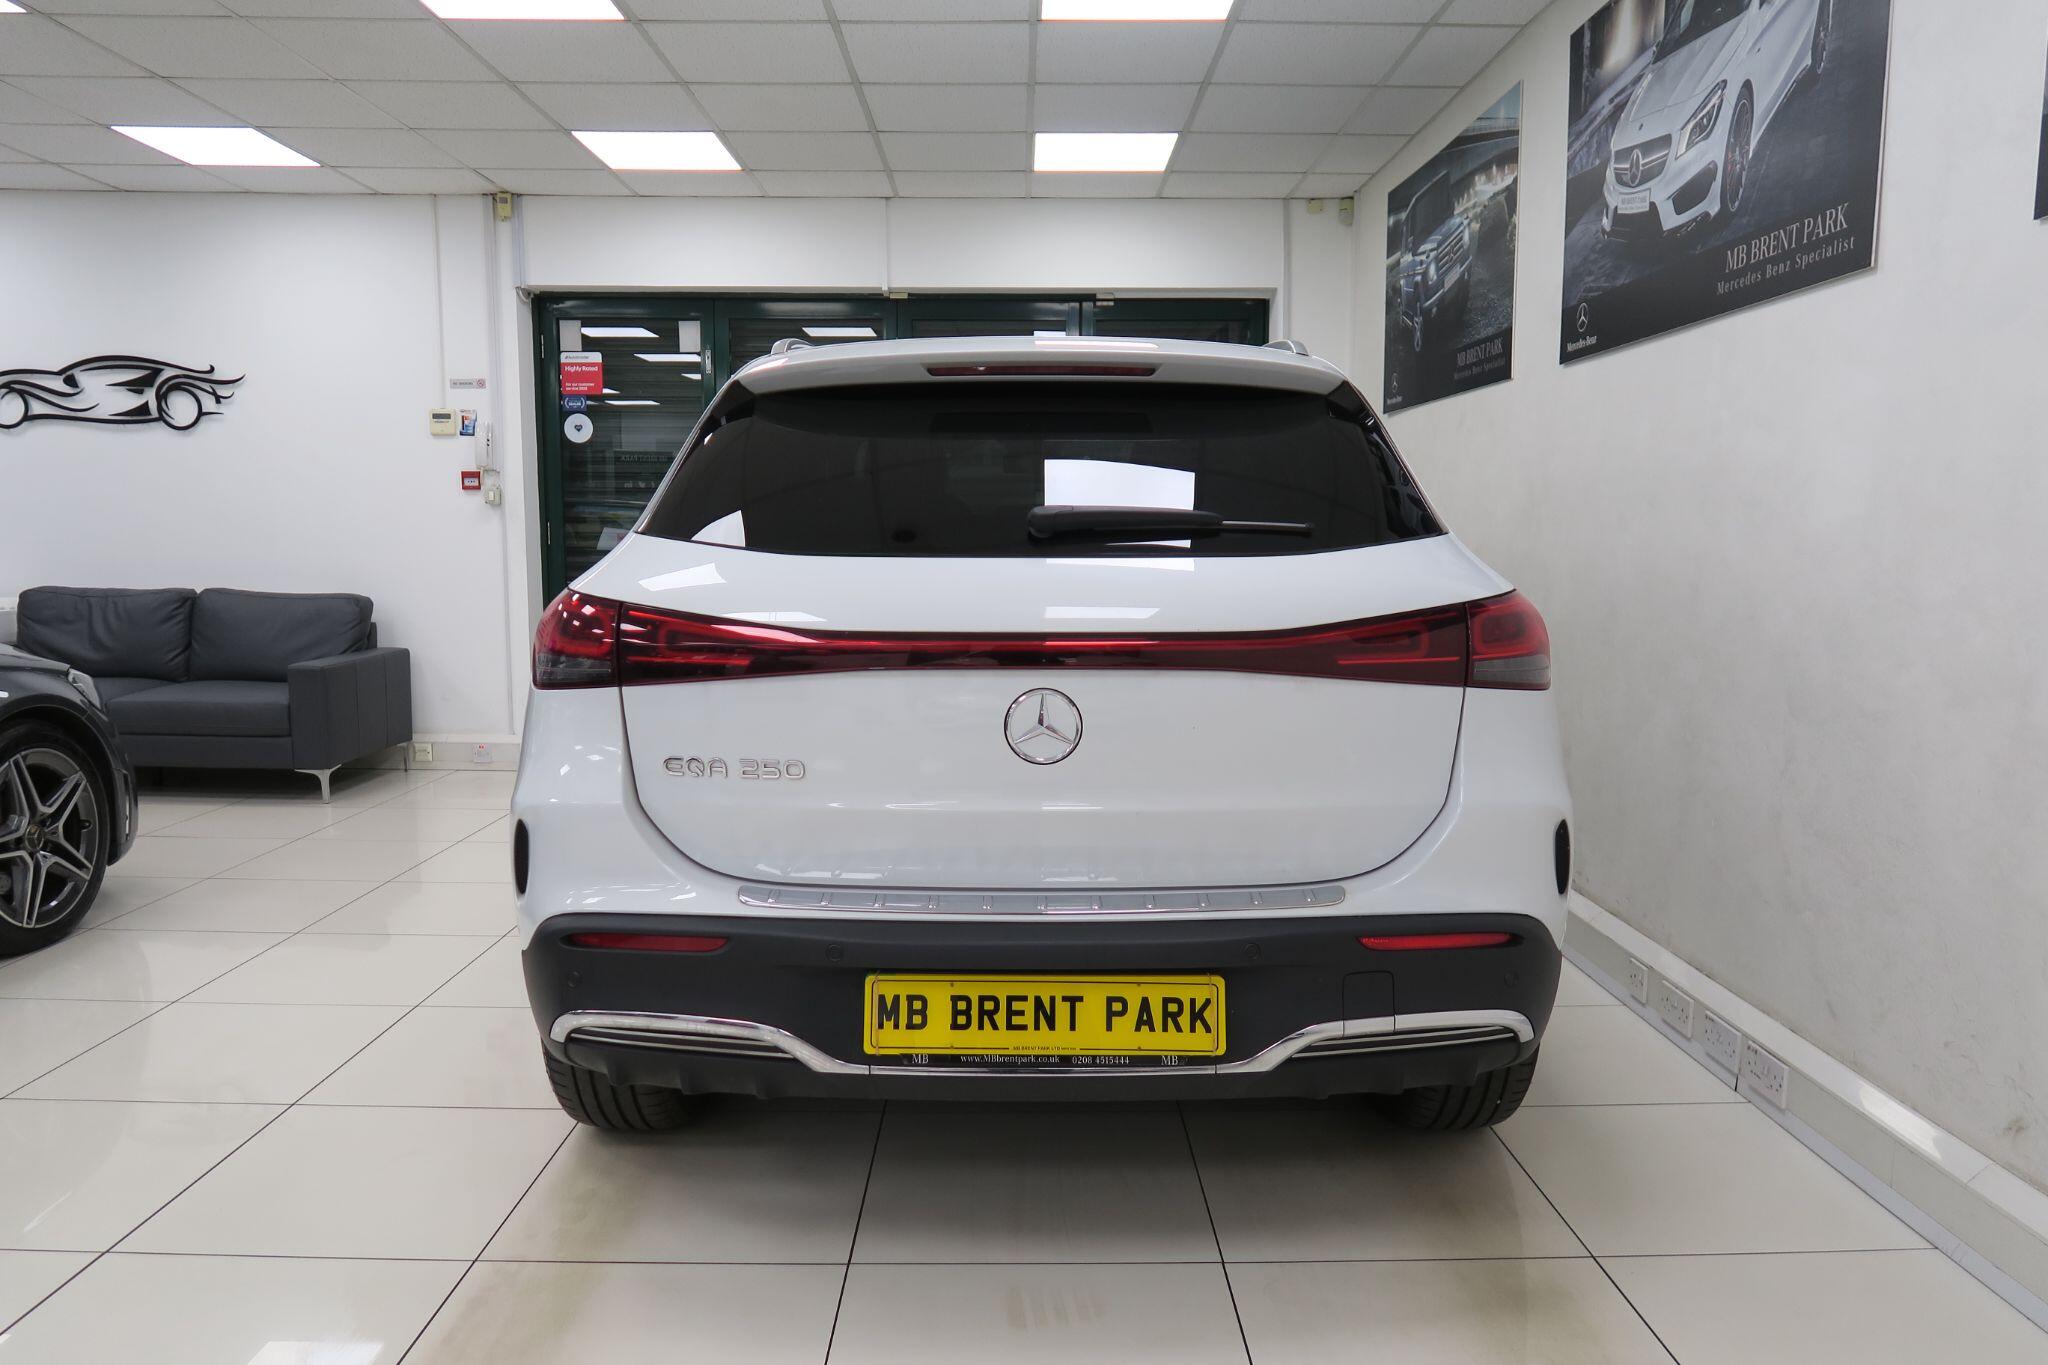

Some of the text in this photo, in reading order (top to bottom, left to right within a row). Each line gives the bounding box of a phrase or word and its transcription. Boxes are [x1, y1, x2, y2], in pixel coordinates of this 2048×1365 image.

[1725, 202, 1849, 273] MB BRENT PARK
[1716, 236, 1855, 295] Mercedes Benz Specialist
[1486, 337, 1503, 358] PARK
[663, 756, 806, 780] EQA 250
[877, 993, 1213, 1034] MB BRENT PARK
[911, 1054, 1179, 1066] MB www.MBbrentpark.co.uk 0208 4515444 MB
